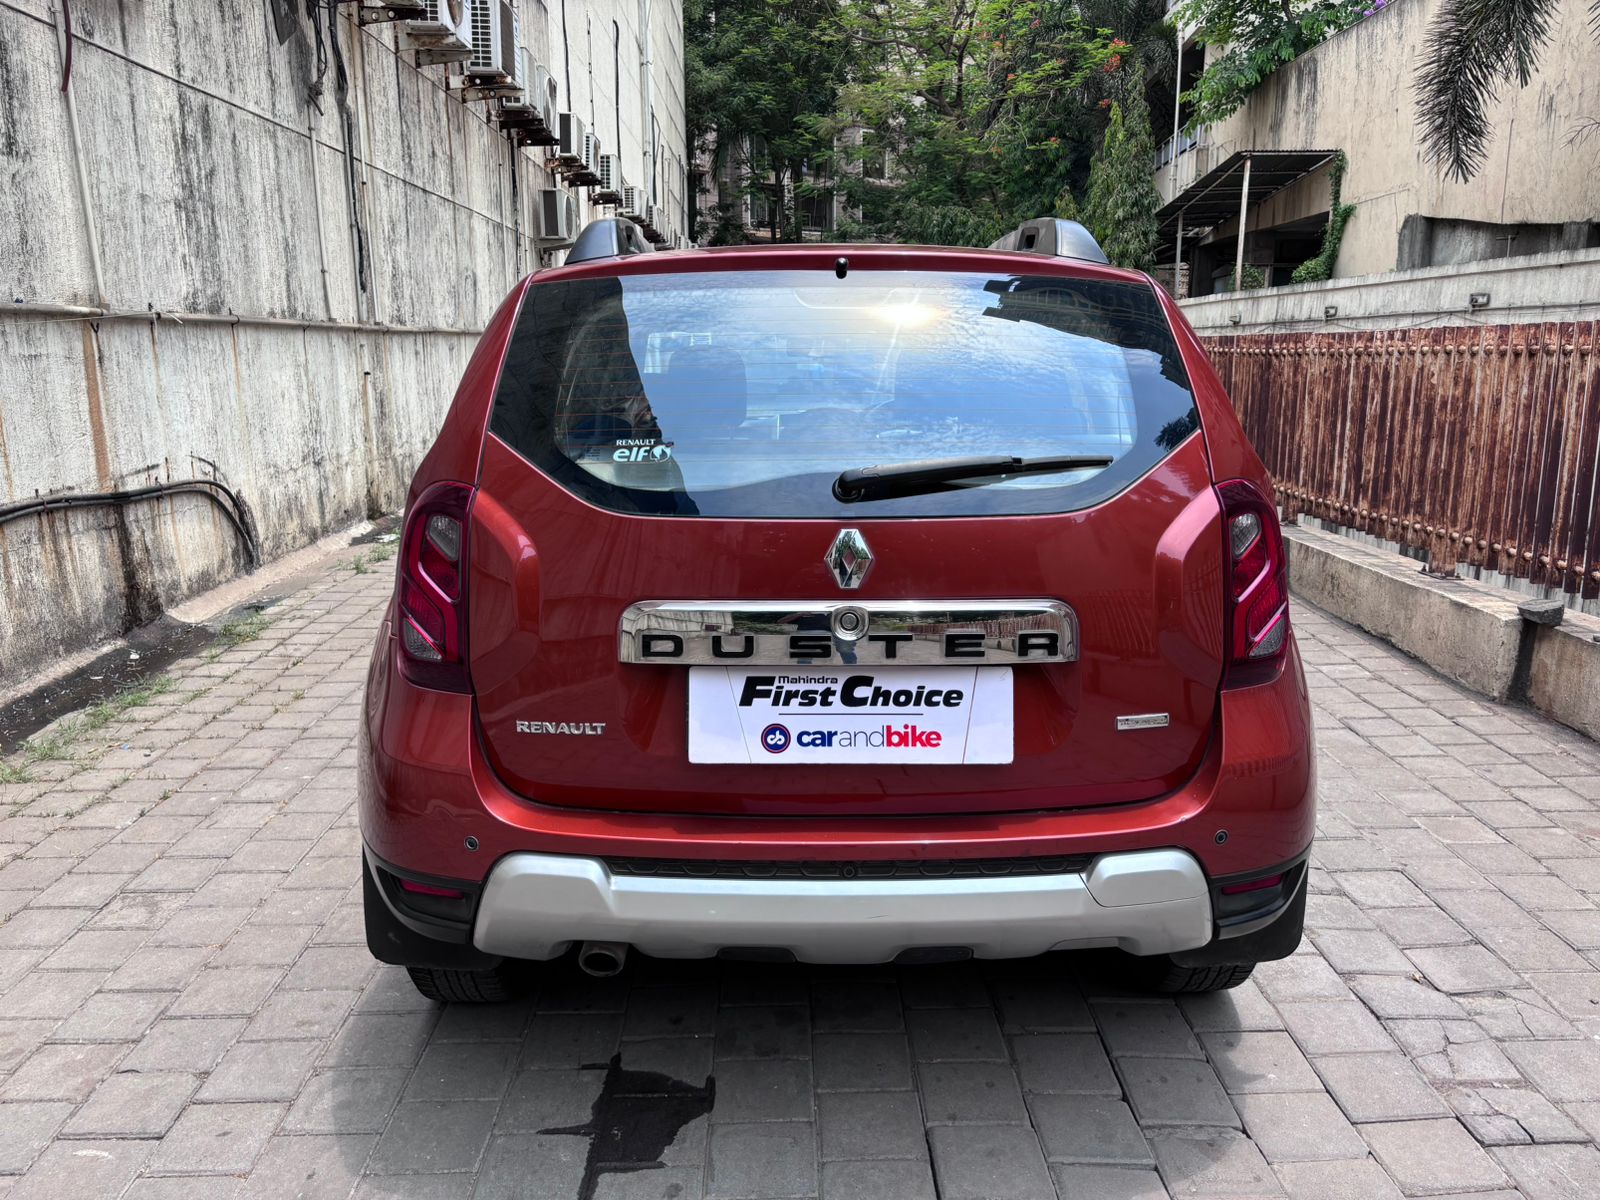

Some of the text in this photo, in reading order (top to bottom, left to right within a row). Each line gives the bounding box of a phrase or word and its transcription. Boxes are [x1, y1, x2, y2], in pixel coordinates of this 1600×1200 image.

[612, 446, 650, 462] elf
[641, 632, 1060, 659] DUSTER
[778, 675, 838, 684] Mahindra
[738, 675, 964, 707] First Choice
[516, 720, 606, 735] RENAULT
[797, 724, 942, 747] carandbike
